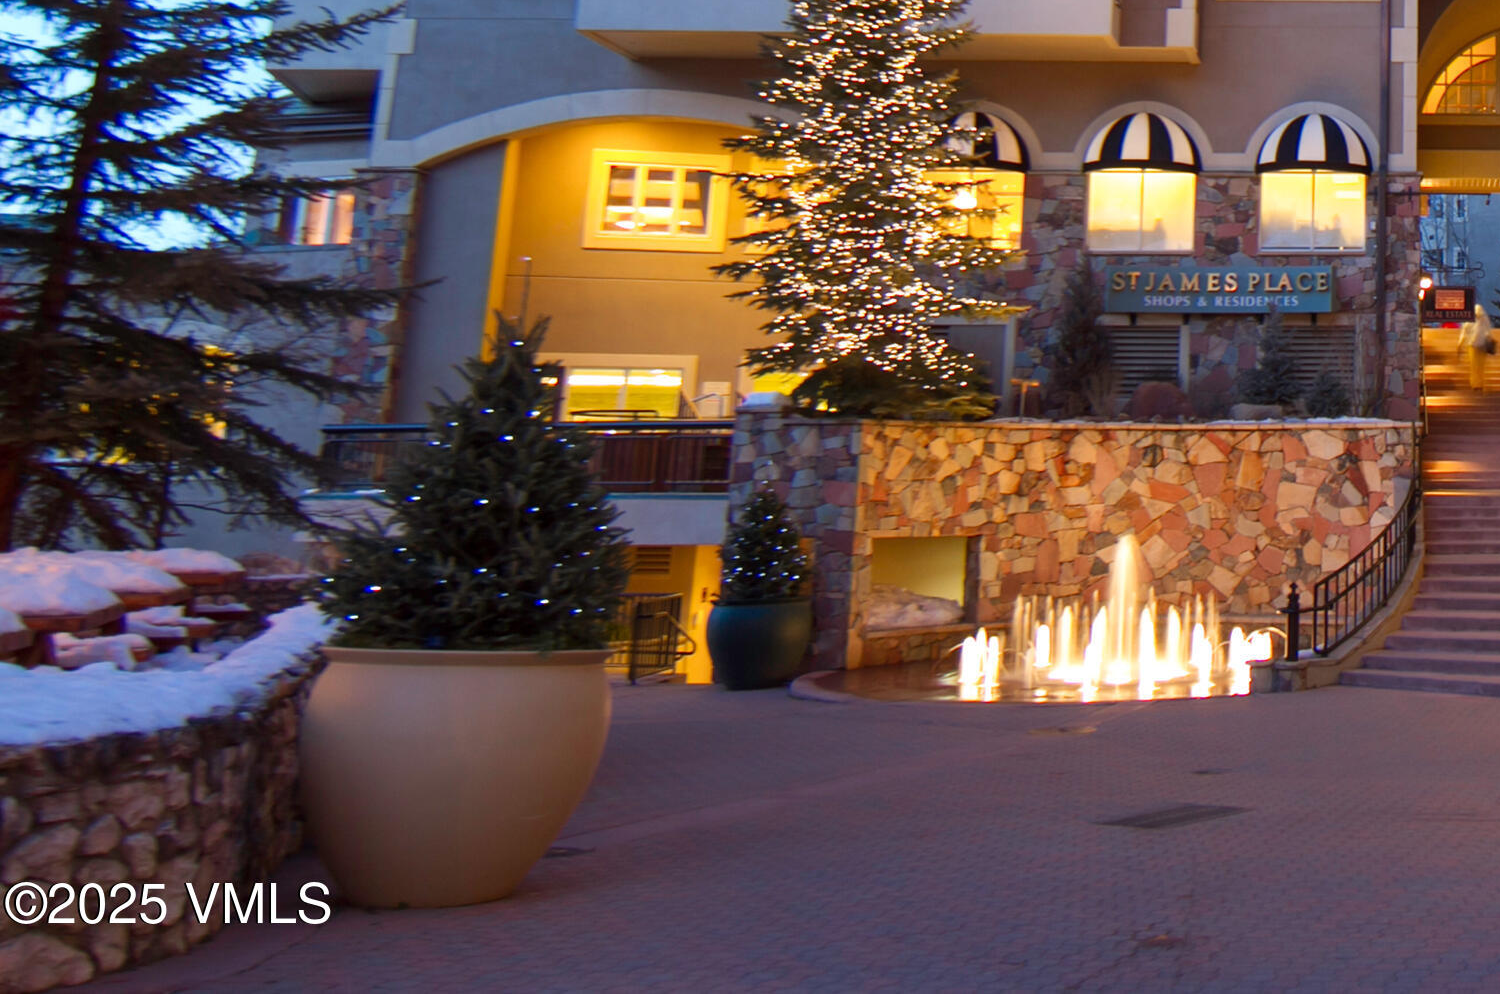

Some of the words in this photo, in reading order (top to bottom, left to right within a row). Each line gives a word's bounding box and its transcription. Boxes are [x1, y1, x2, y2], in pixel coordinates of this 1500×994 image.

[1144, 272, 1239, 293] JAMES
[1247, 272, 1329, 293] PLACE
[1144, 295, 1191, 307] SHOPS
[1197, 296, 1208, 307] &
[1214, 295, 1299, 307] RESIDENCES
[1445, 311, 1472, 319] ESTATE
